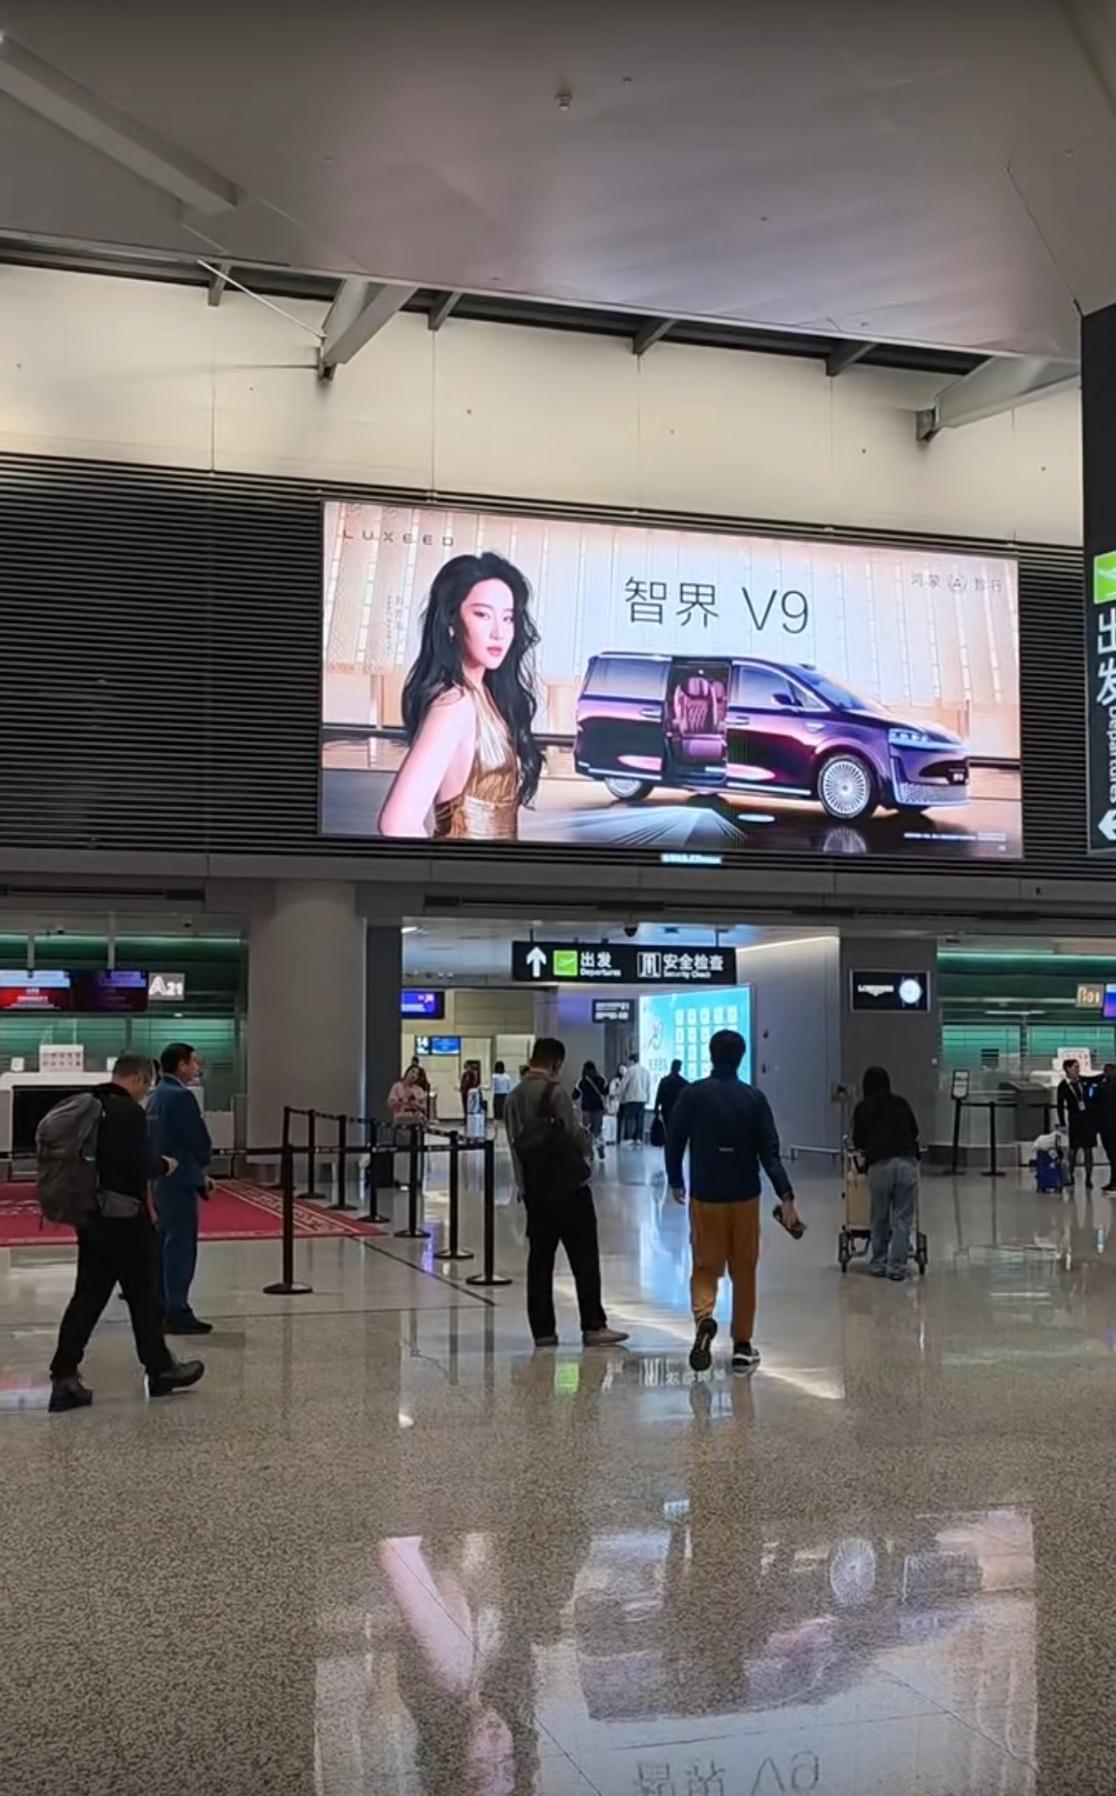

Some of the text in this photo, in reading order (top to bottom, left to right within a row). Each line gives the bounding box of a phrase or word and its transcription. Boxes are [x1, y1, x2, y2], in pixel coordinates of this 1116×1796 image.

[342, 528, 454, 547] LUXEED
[625, 576, 809, 634] 智界 V9
[580, 951, 612, 968] 出发
[663, 953, 723, 970] 安全检查
[149, 975, 184, 996] A21
